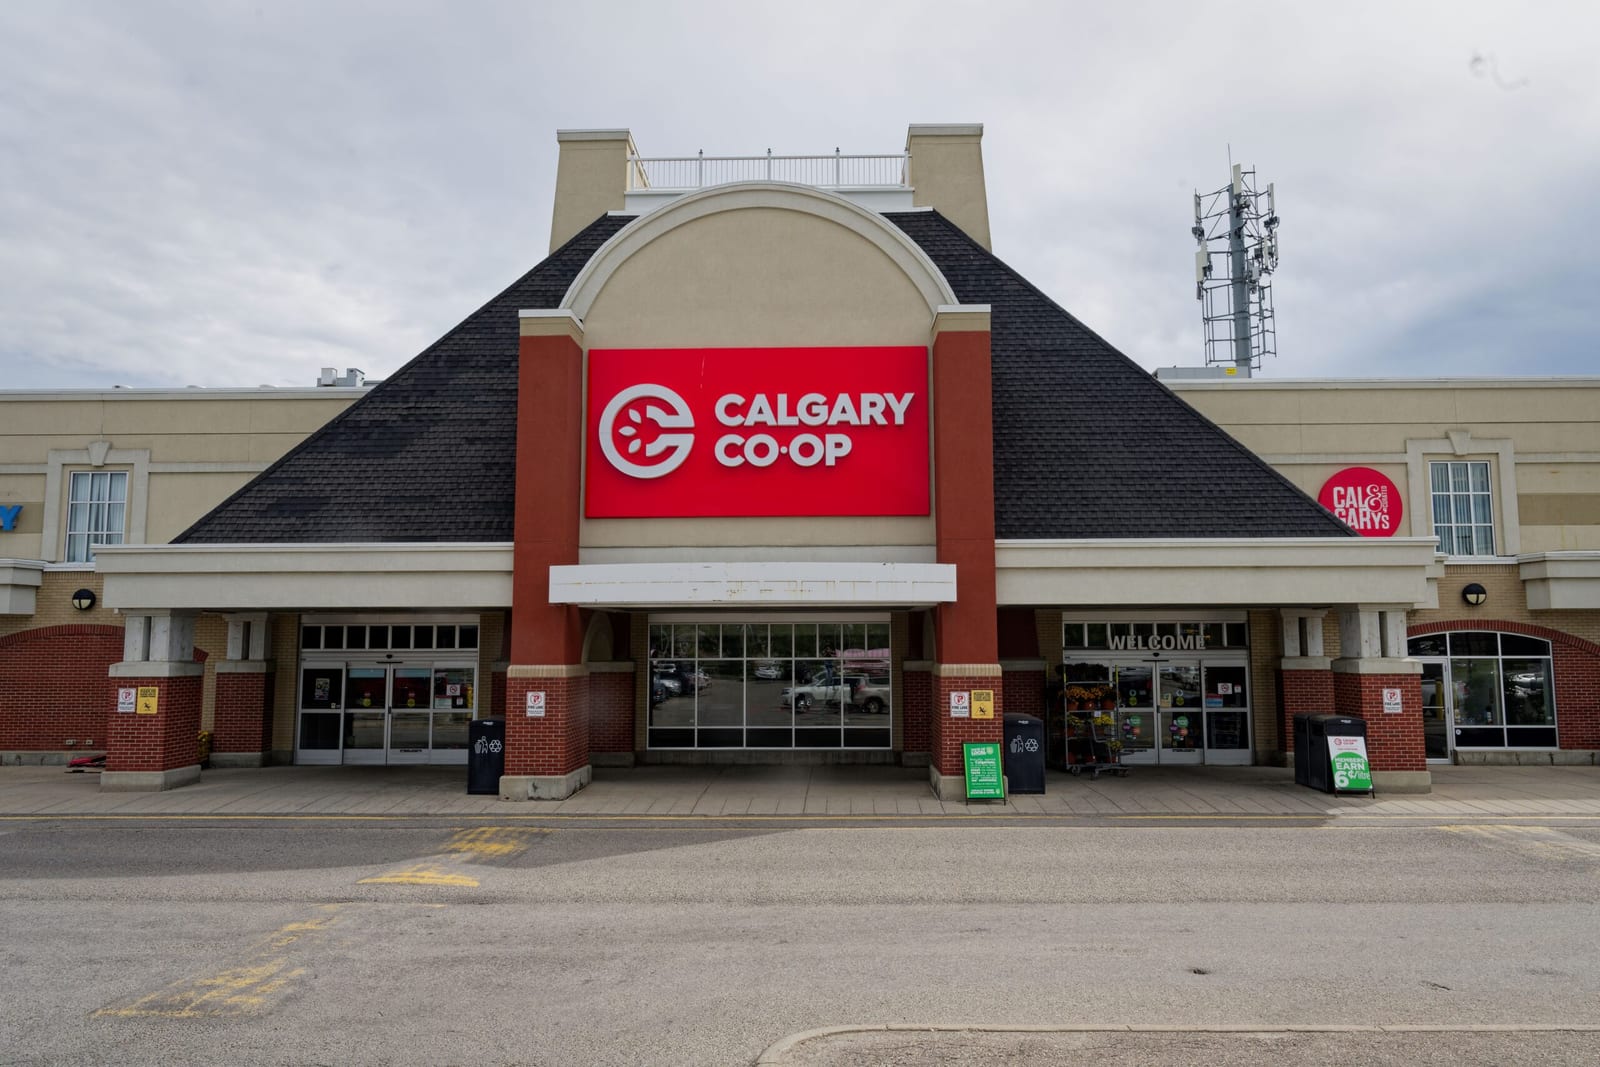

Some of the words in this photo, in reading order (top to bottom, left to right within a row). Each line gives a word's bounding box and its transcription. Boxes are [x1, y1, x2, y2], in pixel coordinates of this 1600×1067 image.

[714, 392, 914, 427] CALGARY
[1333, 486, 1366, 508] CAL
[1107, 634, 1206, 650] WELCOME
